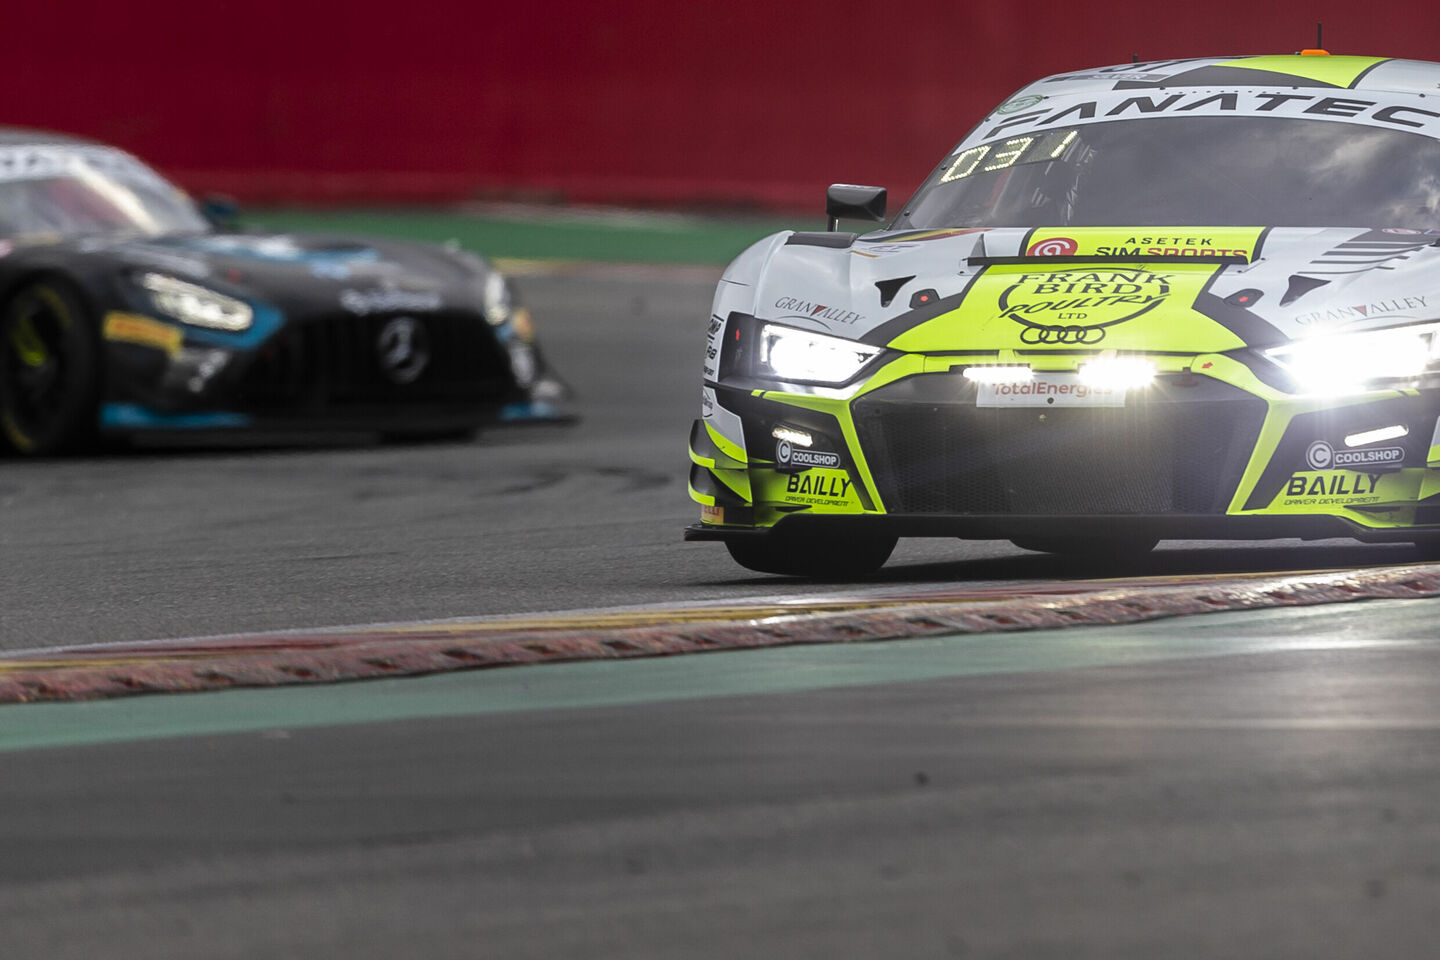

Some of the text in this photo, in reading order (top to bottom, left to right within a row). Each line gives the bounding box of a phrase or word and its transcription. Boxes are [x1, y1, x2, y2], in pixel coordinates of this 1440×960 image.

[940, 130, 1078, 184] 031
[1125, 237, 1213, 246] ASETEK
[1094, 247, 1248, 257] SIM SPORTS
[1017, 272, 1176, 285] FRANK
[1033, 283, 1144, 295] BIRD
[774, 296, 867, 325] GRANVALLEY
[998, 293, 1172, 318] POULTRY
[1295, 295, 1428, 325] GRANVALLEY
[1057, 312, 1088, 321] LTD
[792, 453, 837, 465] COOLSHOP
[1335, 449, 1400, 463] COOLSHOP
[787, 473, 851, 498] BAILLY
[1286, 473, 1383, 497] BAILLY
